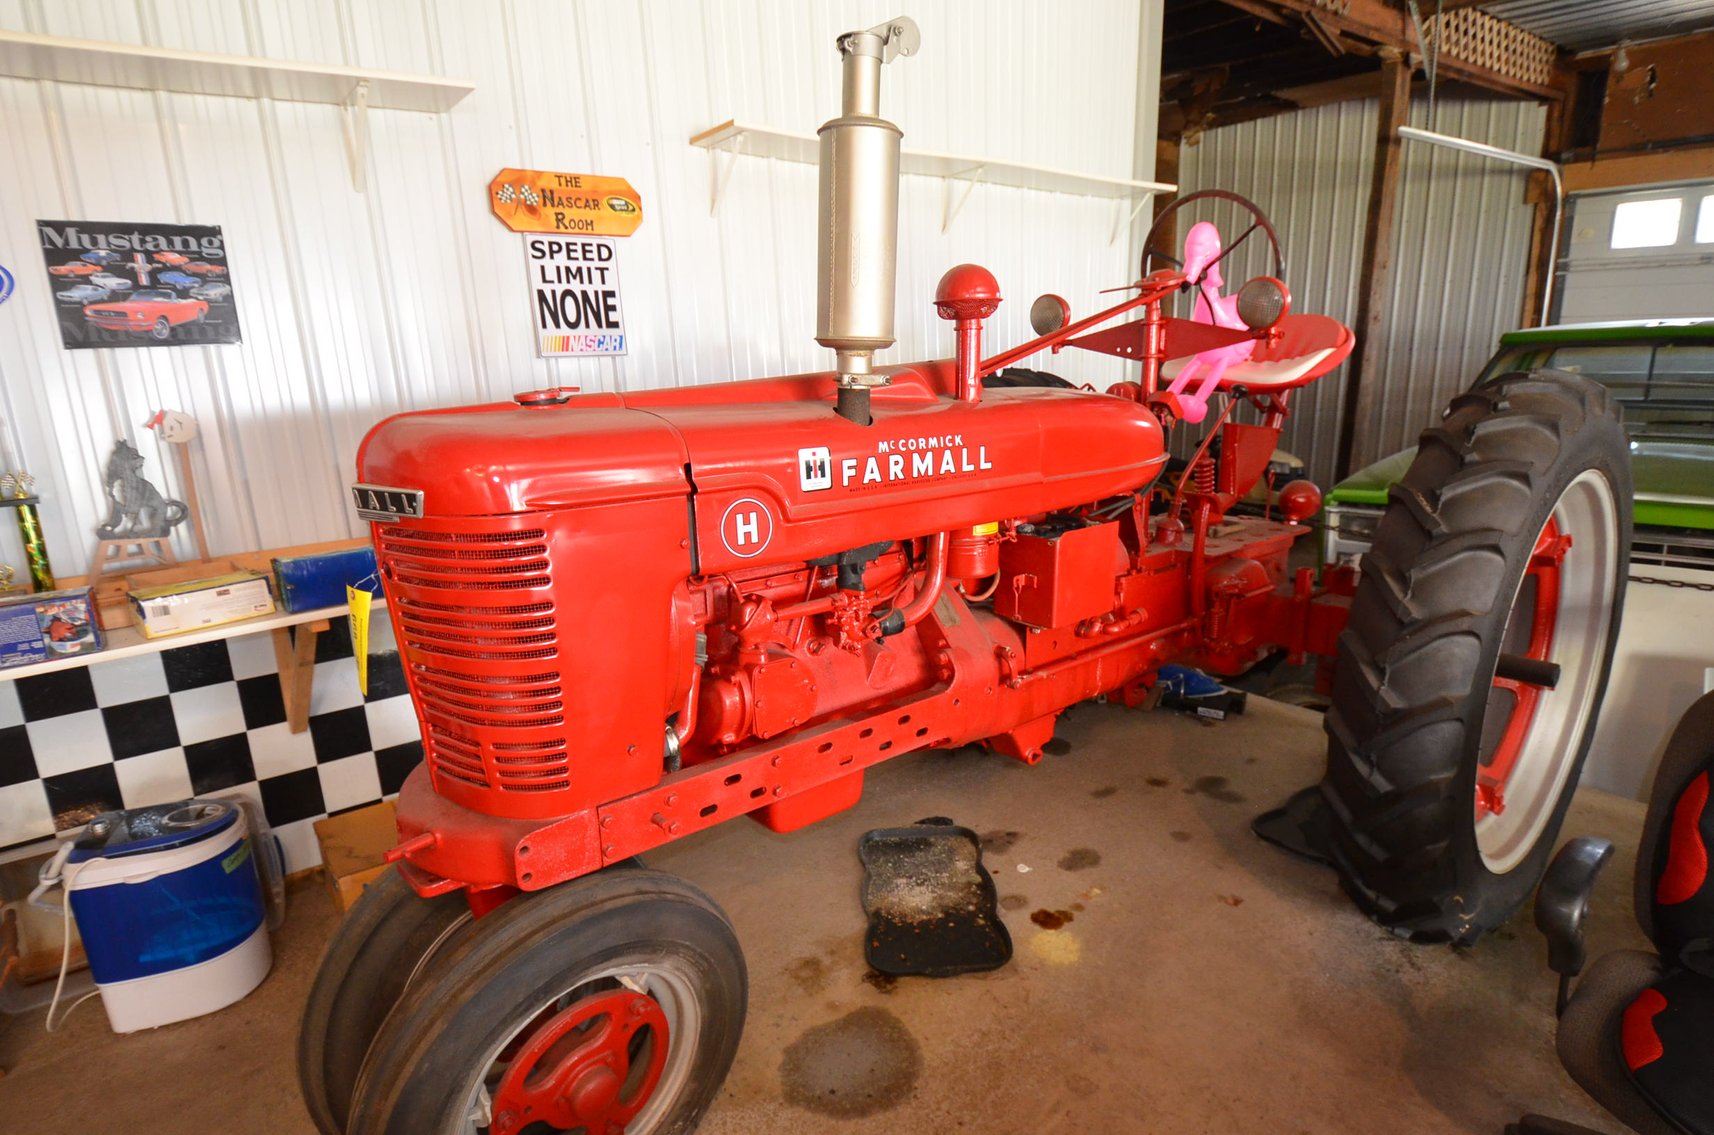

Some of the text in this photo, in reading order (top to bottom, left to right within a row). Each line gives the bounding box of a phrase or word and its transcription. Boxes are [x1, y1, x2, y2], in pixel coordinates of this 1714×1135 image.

[554, 174, 582, 189] THE
[39, 226, 224, 258] Mustang
[530, 240, 613, 262] SPEED
[540, 265, 609, 285] LIMIT
[536, 288, 620, 330] NONE
[570, 335, 624, 352] NASCAR
[841, 445, 993, 487] FARMALL
[735, 511, 759, 546] H
